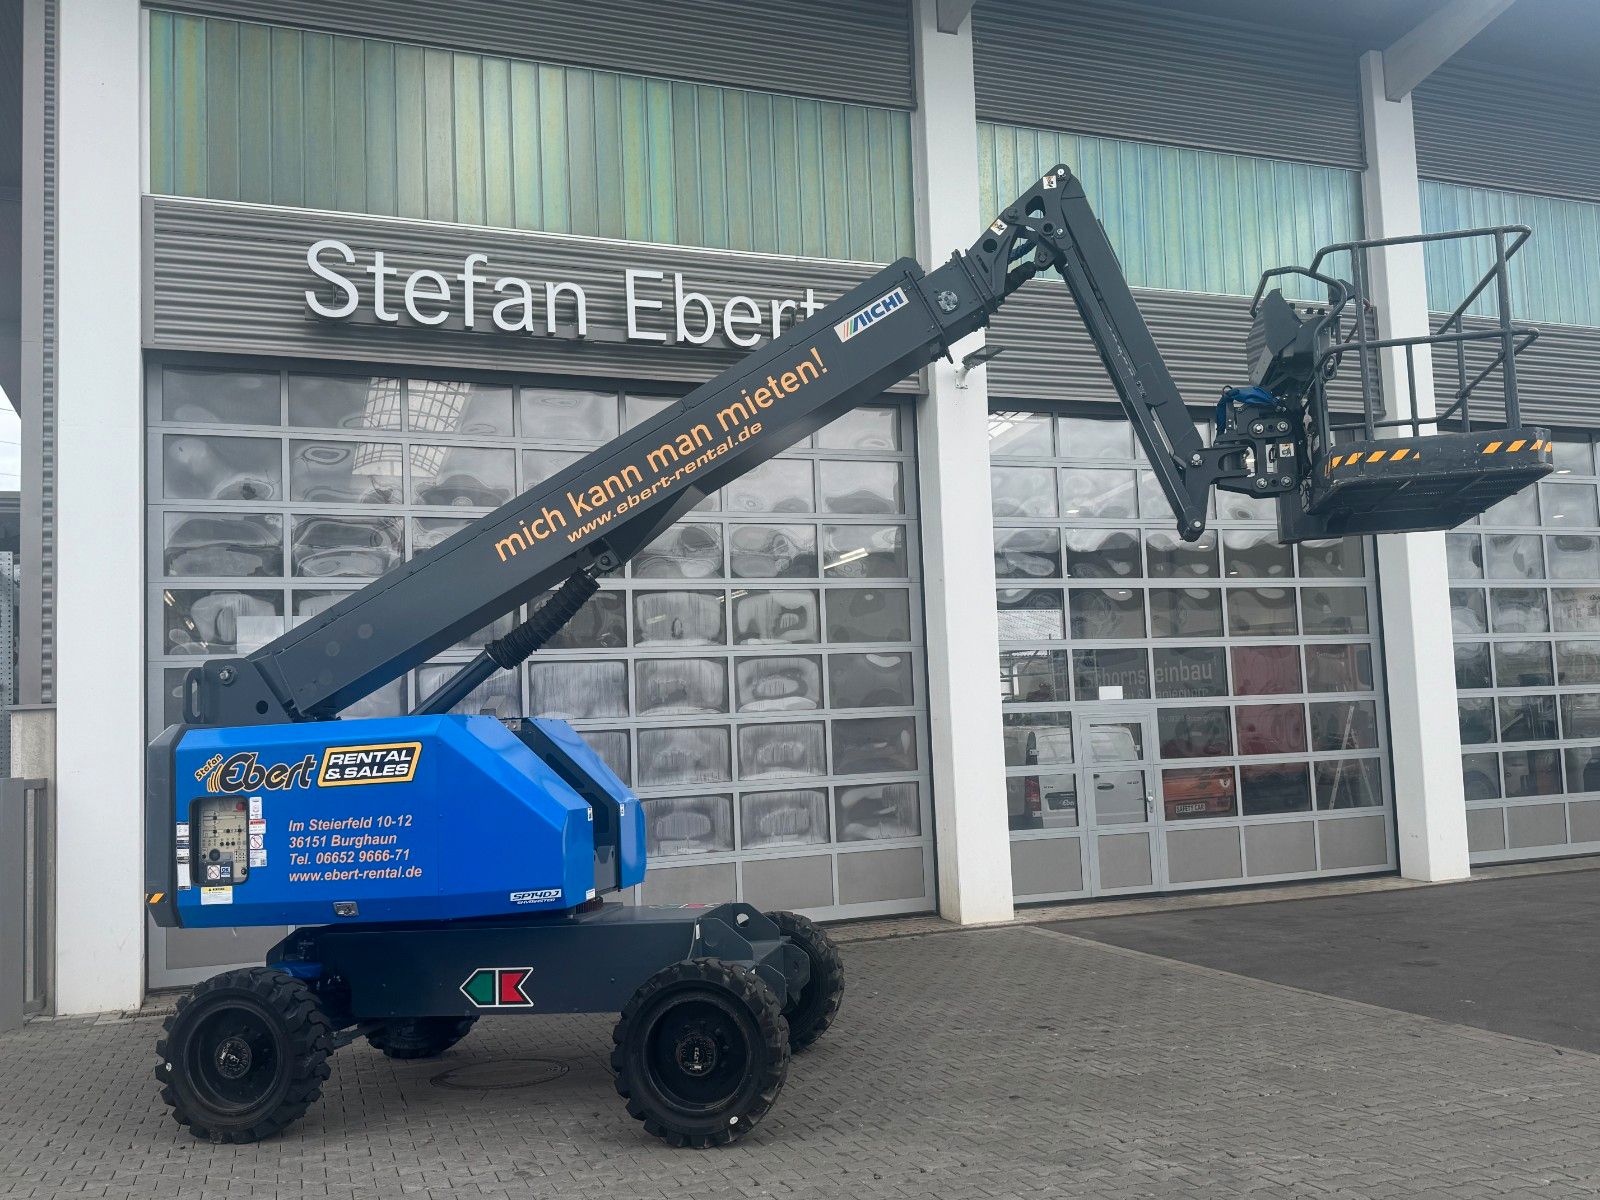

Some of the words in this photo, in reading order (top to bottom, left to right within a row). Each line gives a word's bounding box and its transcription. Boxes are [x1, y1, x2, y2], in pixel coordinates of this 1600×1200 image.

[304, 239, 587, 338] Stefan
[852, 291, 905, 334] AICHI
[494, 507, 567, 563] mich
[566, 464, 644, 518] kann
[646, 423, 714, 475] man
[716, 346, 829, 433] mieten!
[566, 421, 763, 544] www.ebert-rental.de
[195, 754, 223, 781] Stefan
[329, 749, 413, 766] RENTAL
[219, 752, 317, 793] Ebert
[325, 768, 342, 780] &
[344, 763, 409, 779] SALES
[288, 819, 305, 832] Im
[308, 816, 373, 831] Steierfeld
[376, 814, 413, 828] 10-12
[288, 835, 327, 849] 36151
[331, 833, 398, 848] Burghaun
[289, 852, 312, 865] Tel.
[315, 850, 355, 864] 06652
[358, 848, 410, 863] 9666-71
[288, 865, 423, 882] www.ebert-rental.de
